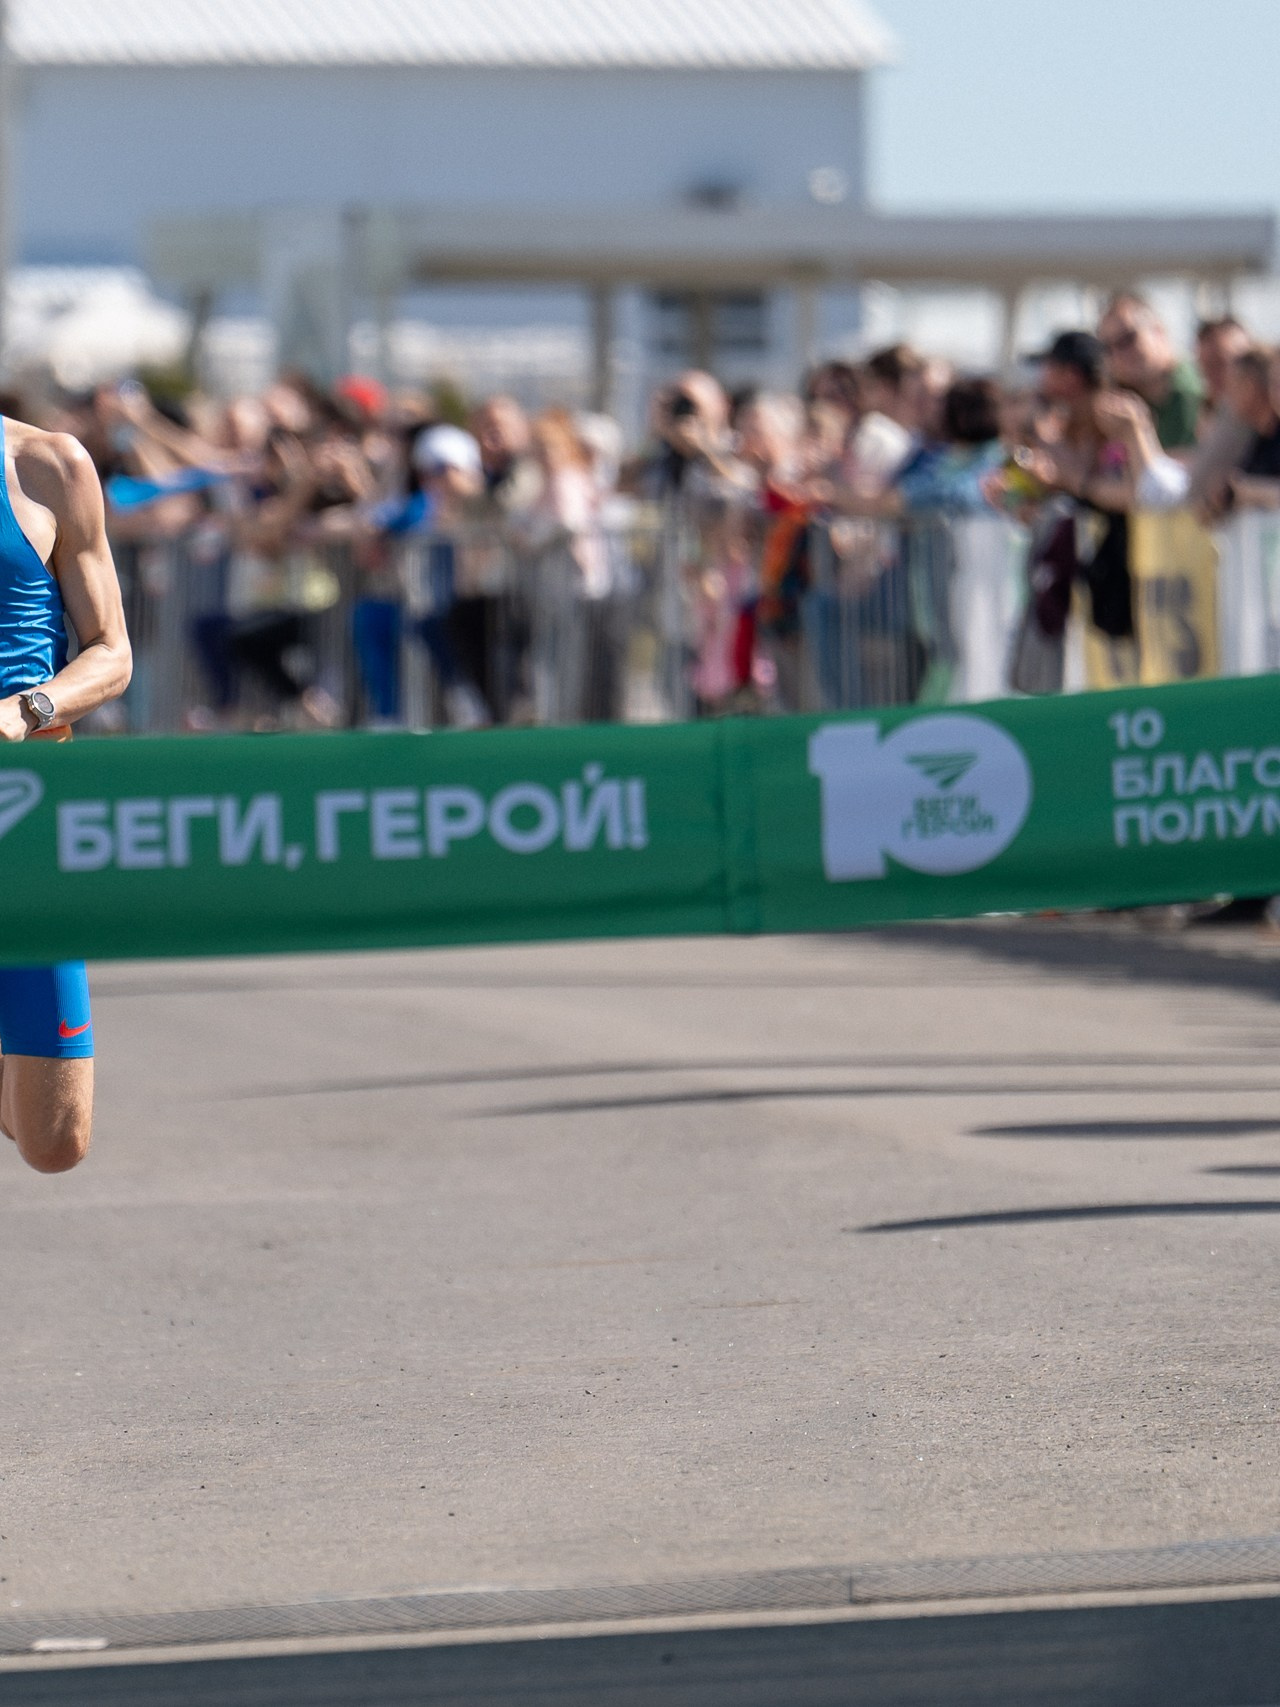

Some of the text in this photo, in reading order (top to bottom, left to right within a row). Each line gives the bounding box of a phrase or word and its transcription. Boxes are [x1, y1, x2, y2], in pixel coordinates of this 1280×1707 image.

[1107, 708, 1165, 749] 10
[809, 713, 1033, 883] 10
[1112, 747, 1280, 800] БЛАГО
[56, 760, 648, 872] БЕГИ, ГЕРОЙ!
